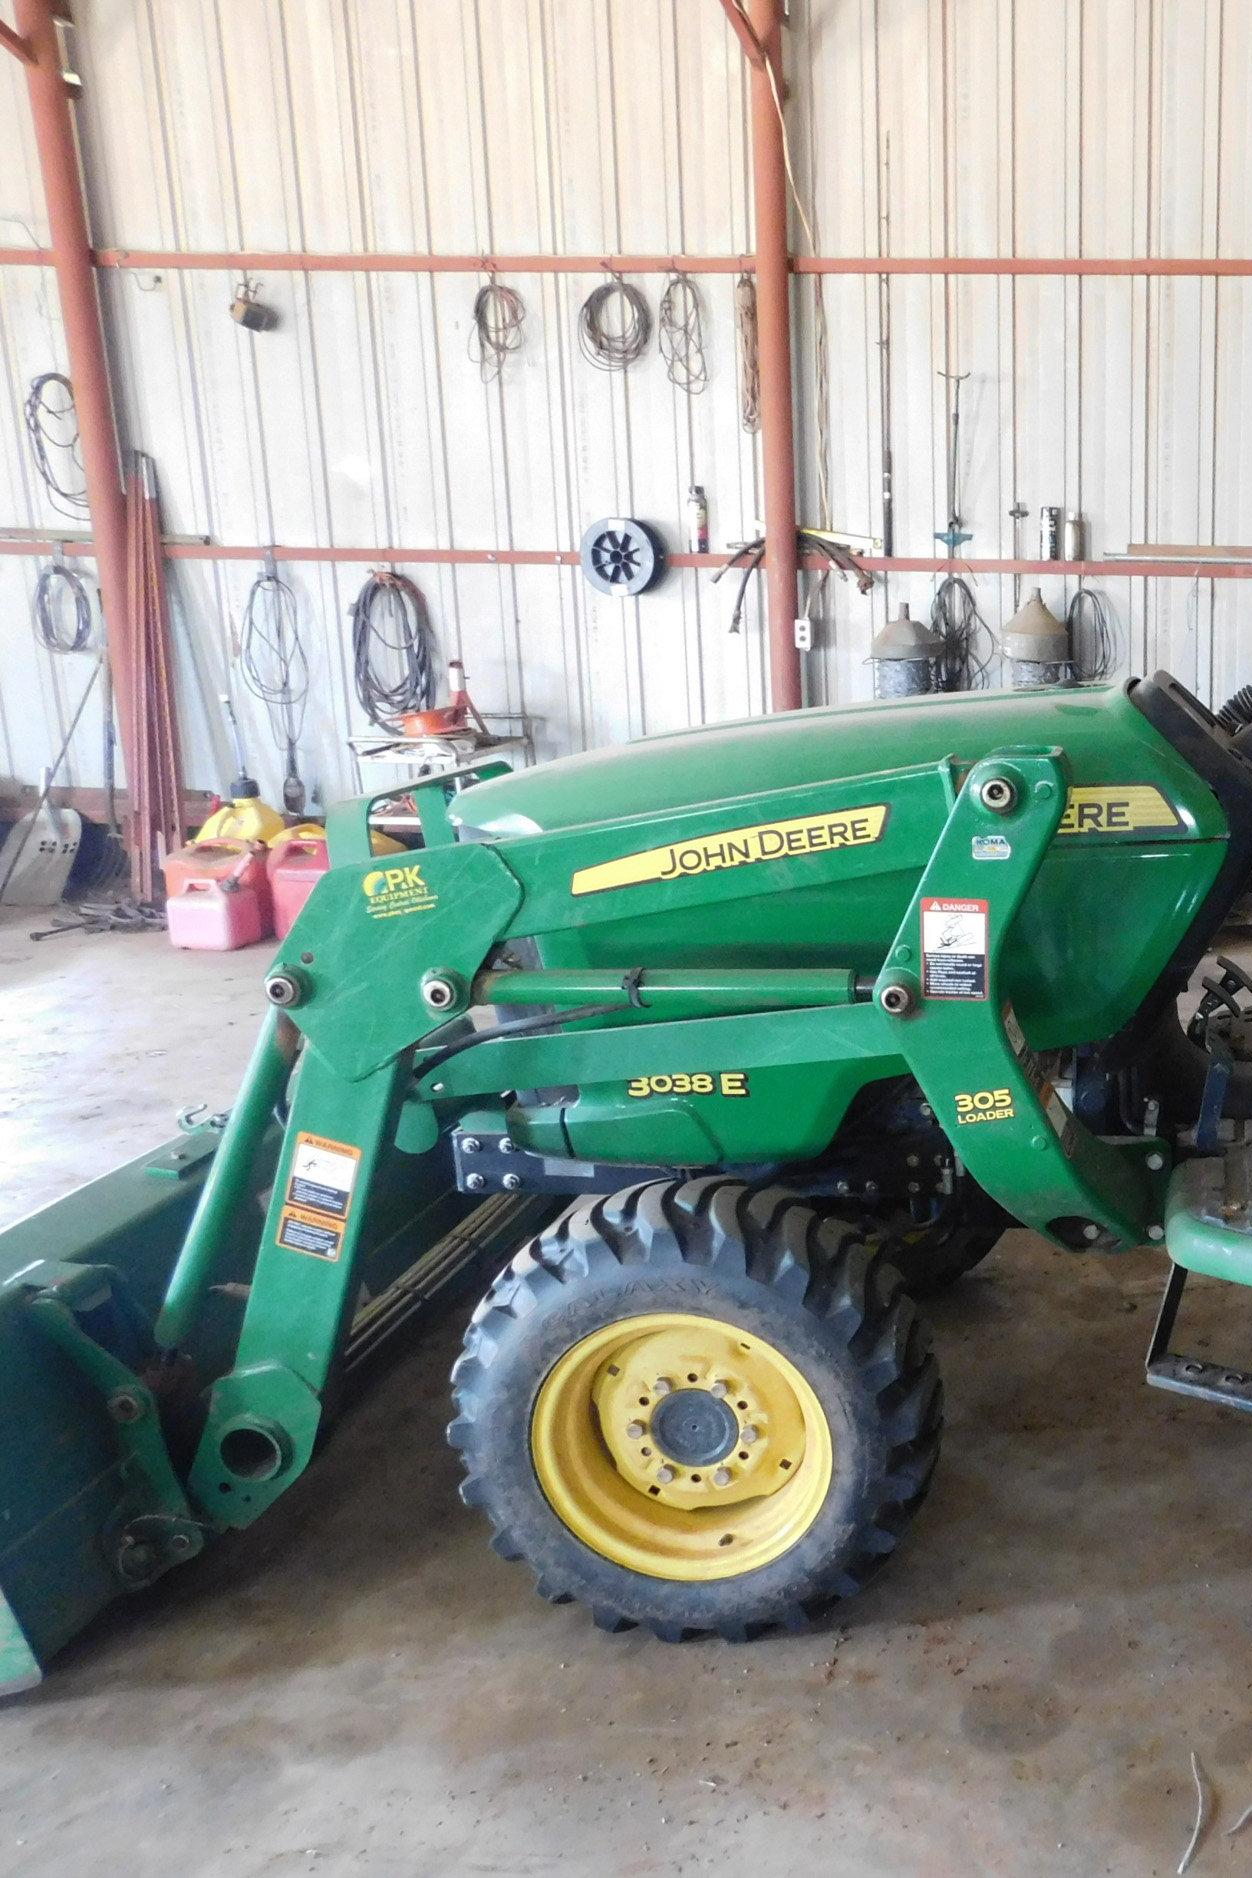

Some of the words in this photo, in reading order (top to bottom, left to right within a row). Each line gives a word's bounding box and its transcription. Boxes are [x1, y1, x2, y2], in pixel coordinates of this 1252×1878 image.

[660, 839, 751, 876] JOHN
[758, 818, 871, 857] DEERE
[371, 887, 429, 904] EQUIPMENT
[942, 903, 980, 912] DANGER
[628, 1072, 714, 1098] 3038
[720, 1073, 747, 1095] E
[955, 1088, 1012, 1112] 305
[958, 1108, 1015, 1124] LOADER
